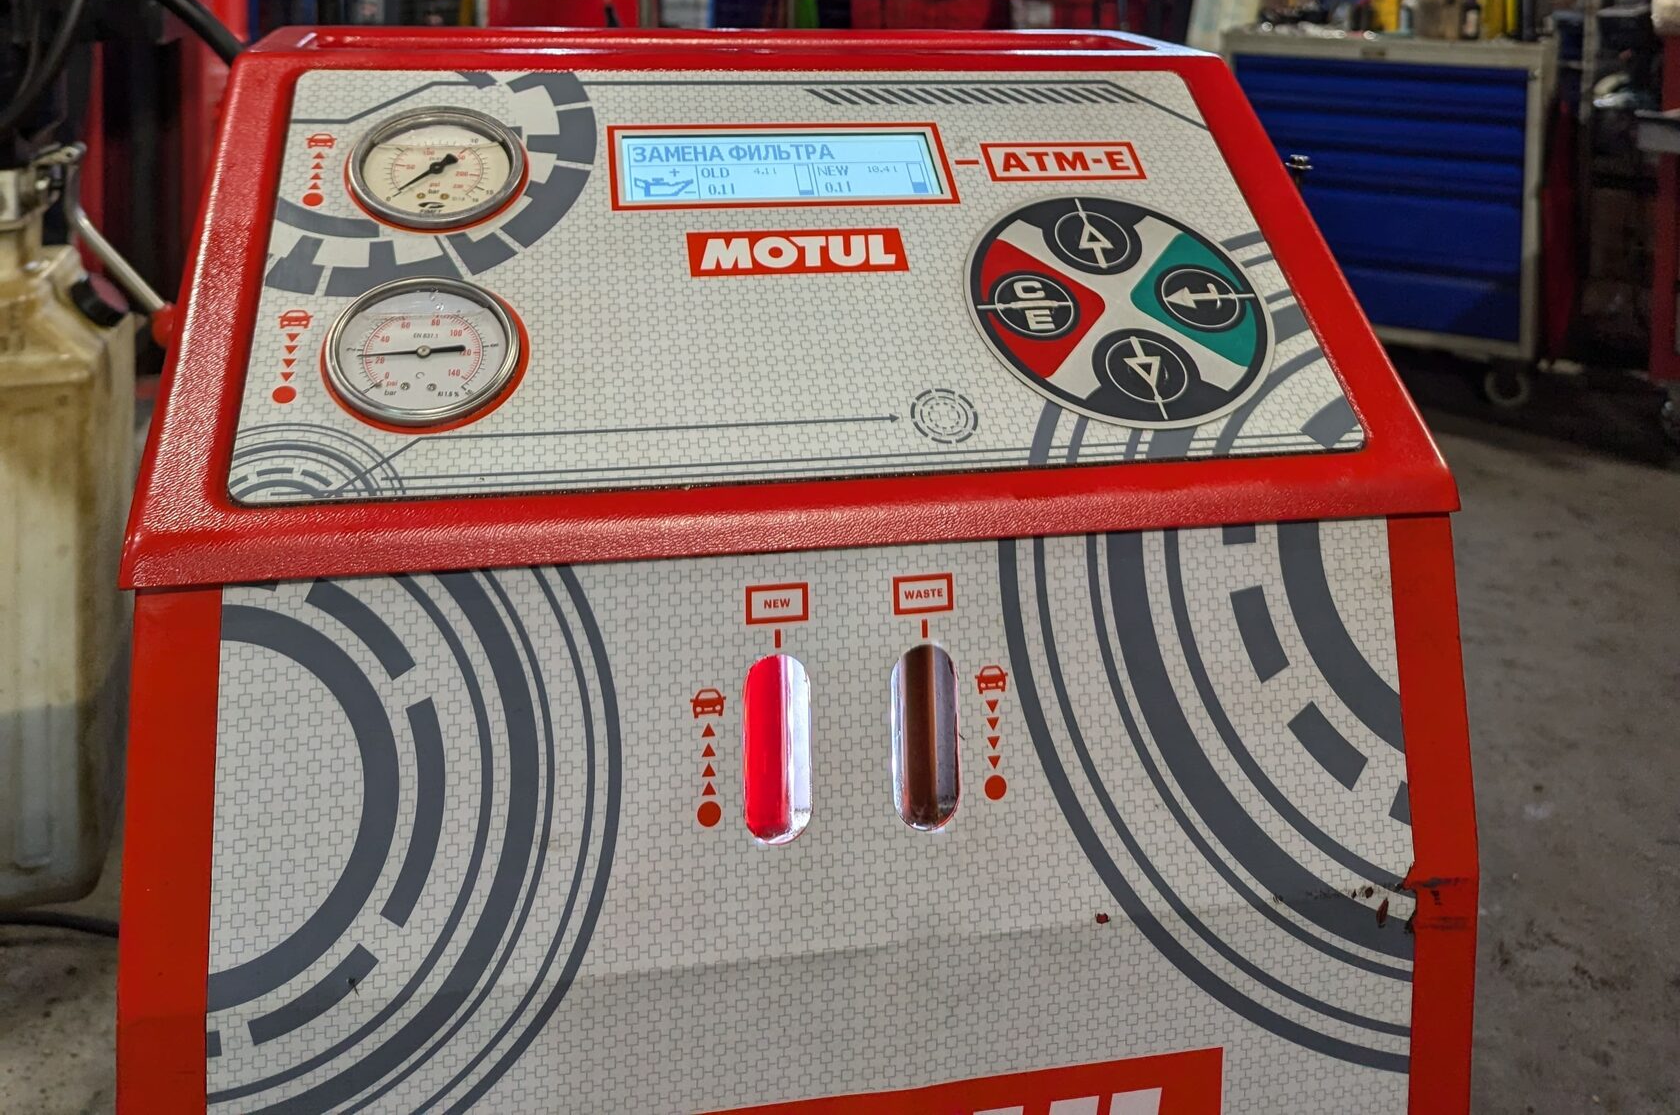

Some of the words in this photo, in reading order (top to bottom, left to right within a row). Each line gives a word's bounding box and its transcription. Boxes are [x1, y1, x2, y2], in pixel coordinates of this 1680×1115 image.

[632, 145, 724, 163] ЗАМЕНА
[728, 144, 836, 161] ФИЛЬТРА
[1002, 150, 1131, 172] ATM-E
[701, 167, 730, 179] OLD
[817, 165, 849, 177] NEW
[700, 234, 896, 270] MOTUL
[450, 329, 463, 337] 100
[448, 369, 461, 377] 140
[904, 588, 943, 600] WASTE
[763, 598, 791, 609] NEW
